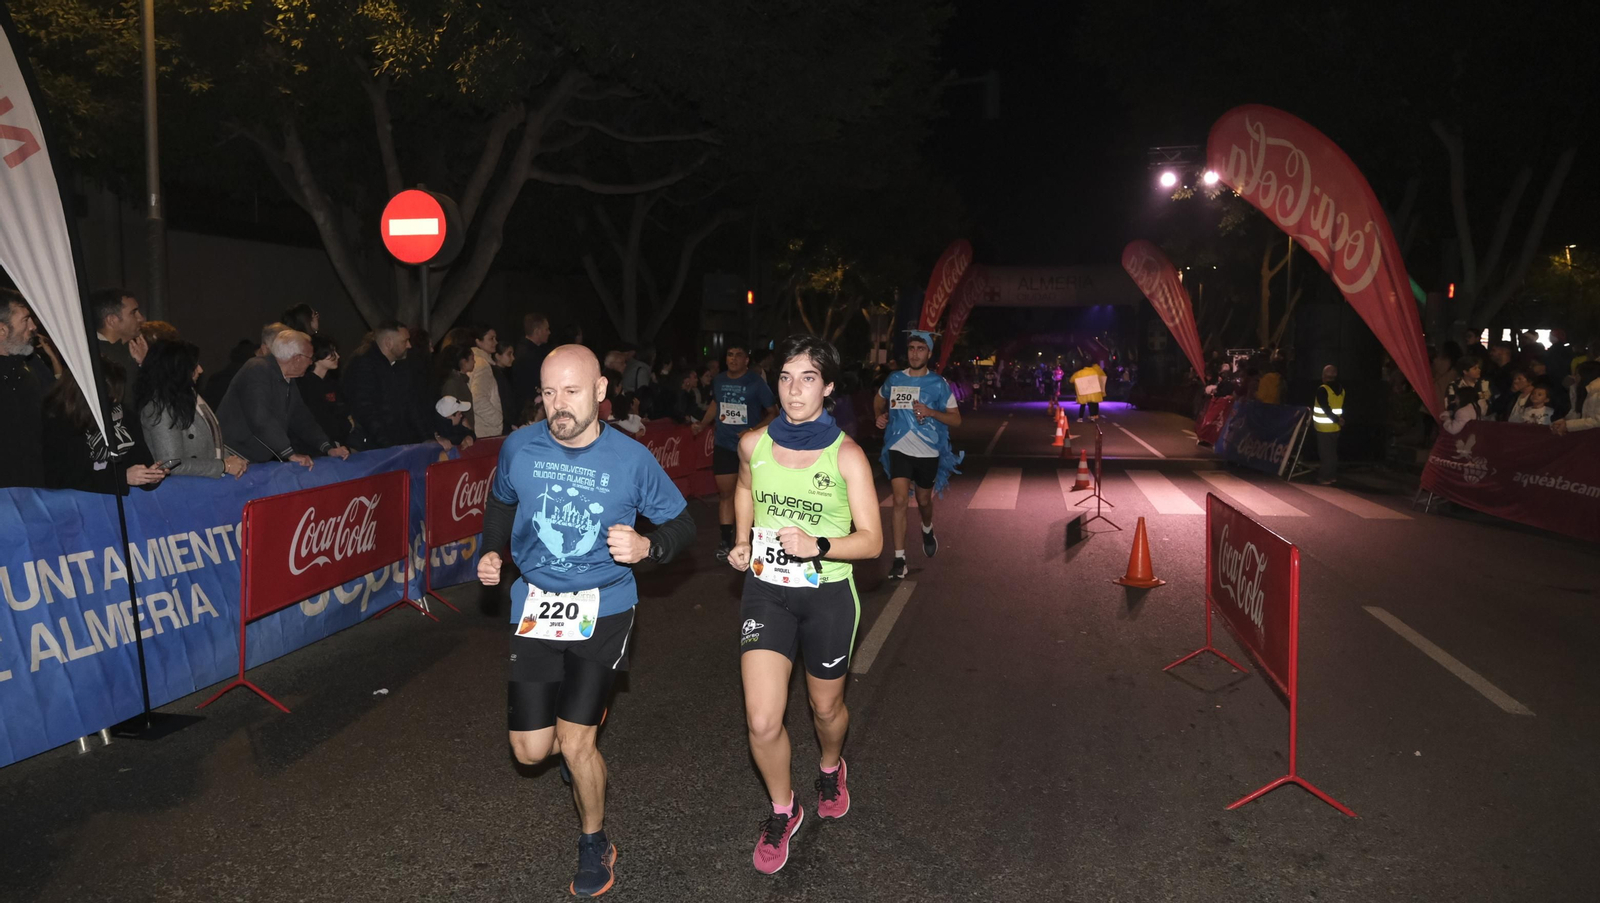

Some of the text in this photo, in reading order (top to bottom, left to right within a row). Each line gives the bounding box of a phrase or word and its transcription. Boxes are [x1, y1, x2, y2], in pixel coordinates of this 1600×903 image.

[926, 246, 968, 328] Coca-Cola
[896, 393, 912, 401] 250
[726, 410, 741, 418] 564
[533, 469, 556, 480] CIUDAD
[557, 472, 566, 481] DE
[534, 460, 597, 478] XIV SAN SILVESTRE
[755, 489, 823, 513] Universo
[767, 505, 822, 525] Running
[288, 492, 383, 576] Coca-Cola
[1218, 524, 1269, 630] Coca-Cola
[538, 602, 580, 620] 220
[30, 578, 220, 673] ALMERÍA
